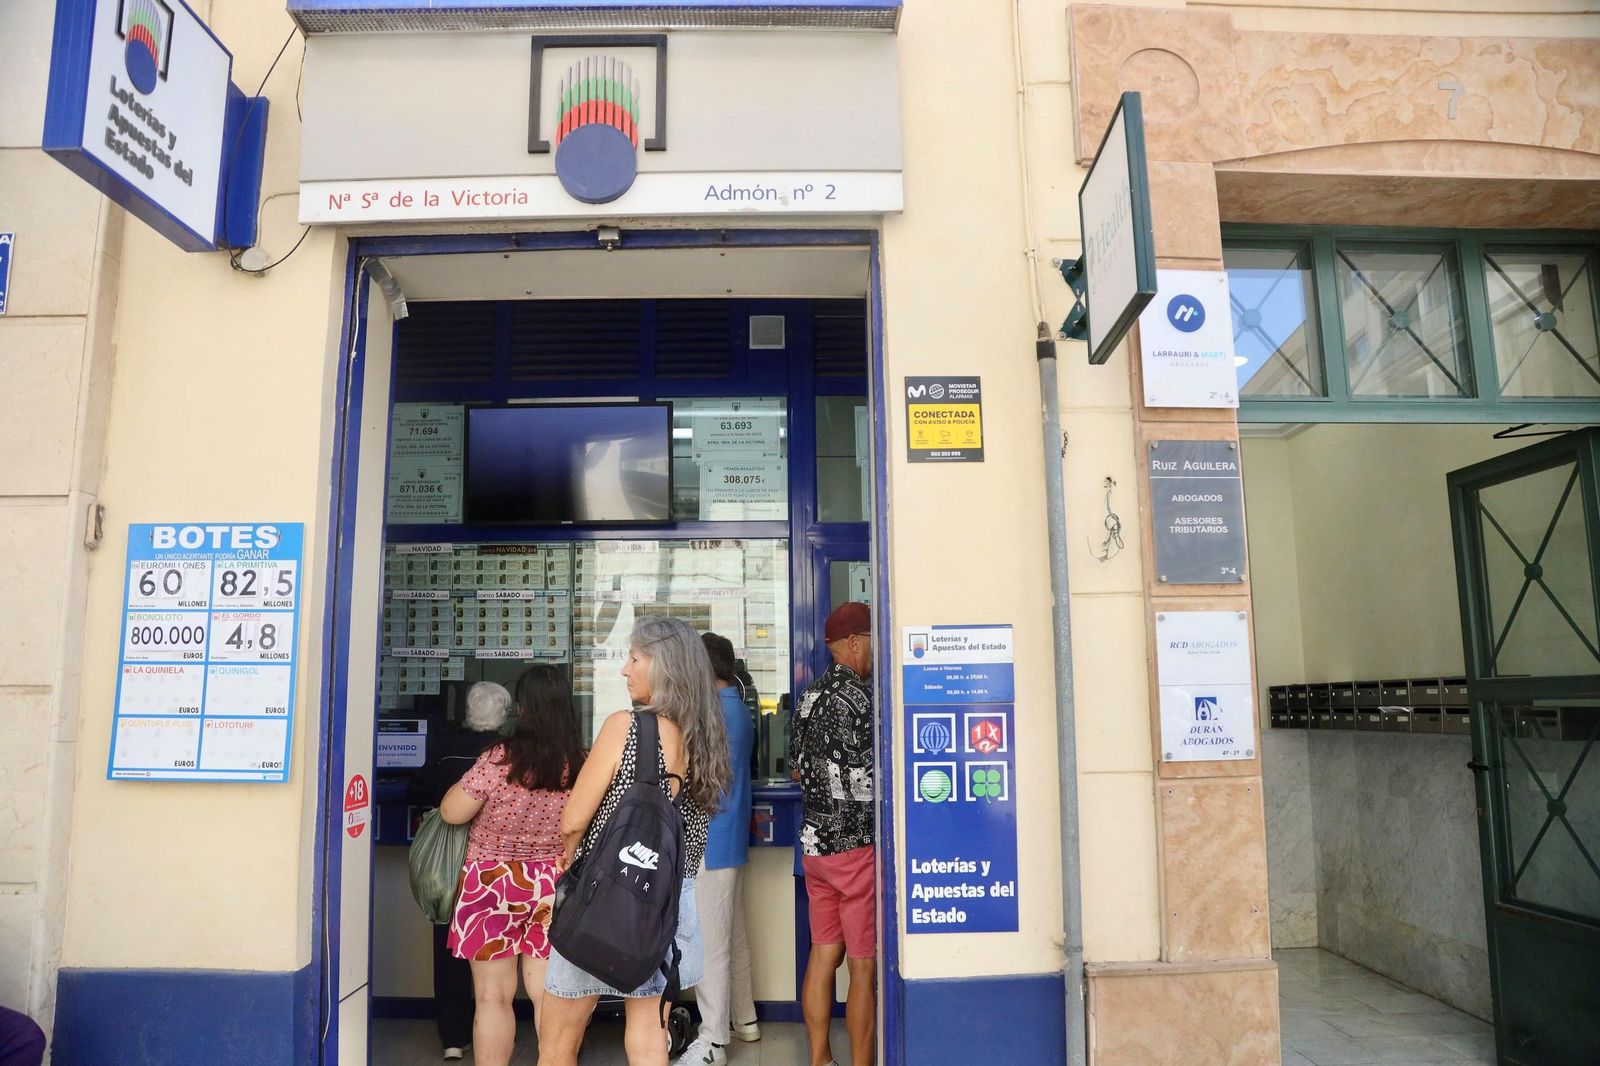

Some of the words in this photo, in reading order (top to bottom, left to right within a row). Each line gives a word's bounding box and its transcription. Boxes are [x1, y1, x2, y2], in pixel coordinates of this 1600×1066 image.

[1438, 82, 1463, 120] 7
[110, 74, 166, 138] Loterías
[168, 131, 177, 150] y
[108, 103, 171, 169] Apuestas
[174, 160, 193, 187] del
[105, 126, 154, 180] Estado
[793, 184, 814, 200] nº
[825, 184, 836, 200] 2
[328, 193, 351, 210] Nª
[361, 192, 379, 208] Sª
[389, 191, 414, 207] de
[424, 190, 440, 207] la
[451, 188, 528, 206] Victoria
[409, 427, 438, 435] 71.694
[720, 421, 752, 430] 63.693
[1152, 460, 1177, 470] RUIZ
[1183, 461, 1236, 471] AGUILERA
[723, 475, 761, 484] 308.075
[400, 485, 435, 493] 871.036
[437, 485, 443, 493] €
[1172, 494, 1223, 502] ABOGADOS
[1174, 517, 1223, 525] ASESORES
[1169, 526, 1229, 534] TRIBUTARIOS
[153, 525, 278, 549] BOTES
[181, 552, 214, 560] ACERTANTE
[237, 549, 269, 560] GANAR
[224, 561, 235, 569] LA
[236, 561, 278, 569] PRIMITIVA
[139, 569, 182, 596] 60
[136, 613, 183, 621] BONOLOTO
[131, 626, 205, 645] 800.000
[224, 622, 276, 650] 4,8
[931, 635, 962, 643] Loterías
[932, 644, 966, 652] Apuestas
[981, 643, 1007, 651] Estado
[1170, 641, 1189, 649] RCD
[1189, 640, 1238, 648] ABOGADOS
[218, 667, 259, 675] QUINIGOL
[214, 721, 255, 729] LOTOTURF
[1190, 723, 1223, 734] DURÁN
[1180, 737, 1234, 746] ABOGADOS
[349, 780, 364, 801] +18
[628, 841, 659, 865] NIKE
[912, 857, 977, 873] Loterías
[981, 860, 991, 877] y
[620, 866, 650, 892] AIR
[912, 883, 985, 902] Apuestas
[990, 881, 1015, 897] del
[912, 907, 967, 924] Estado
